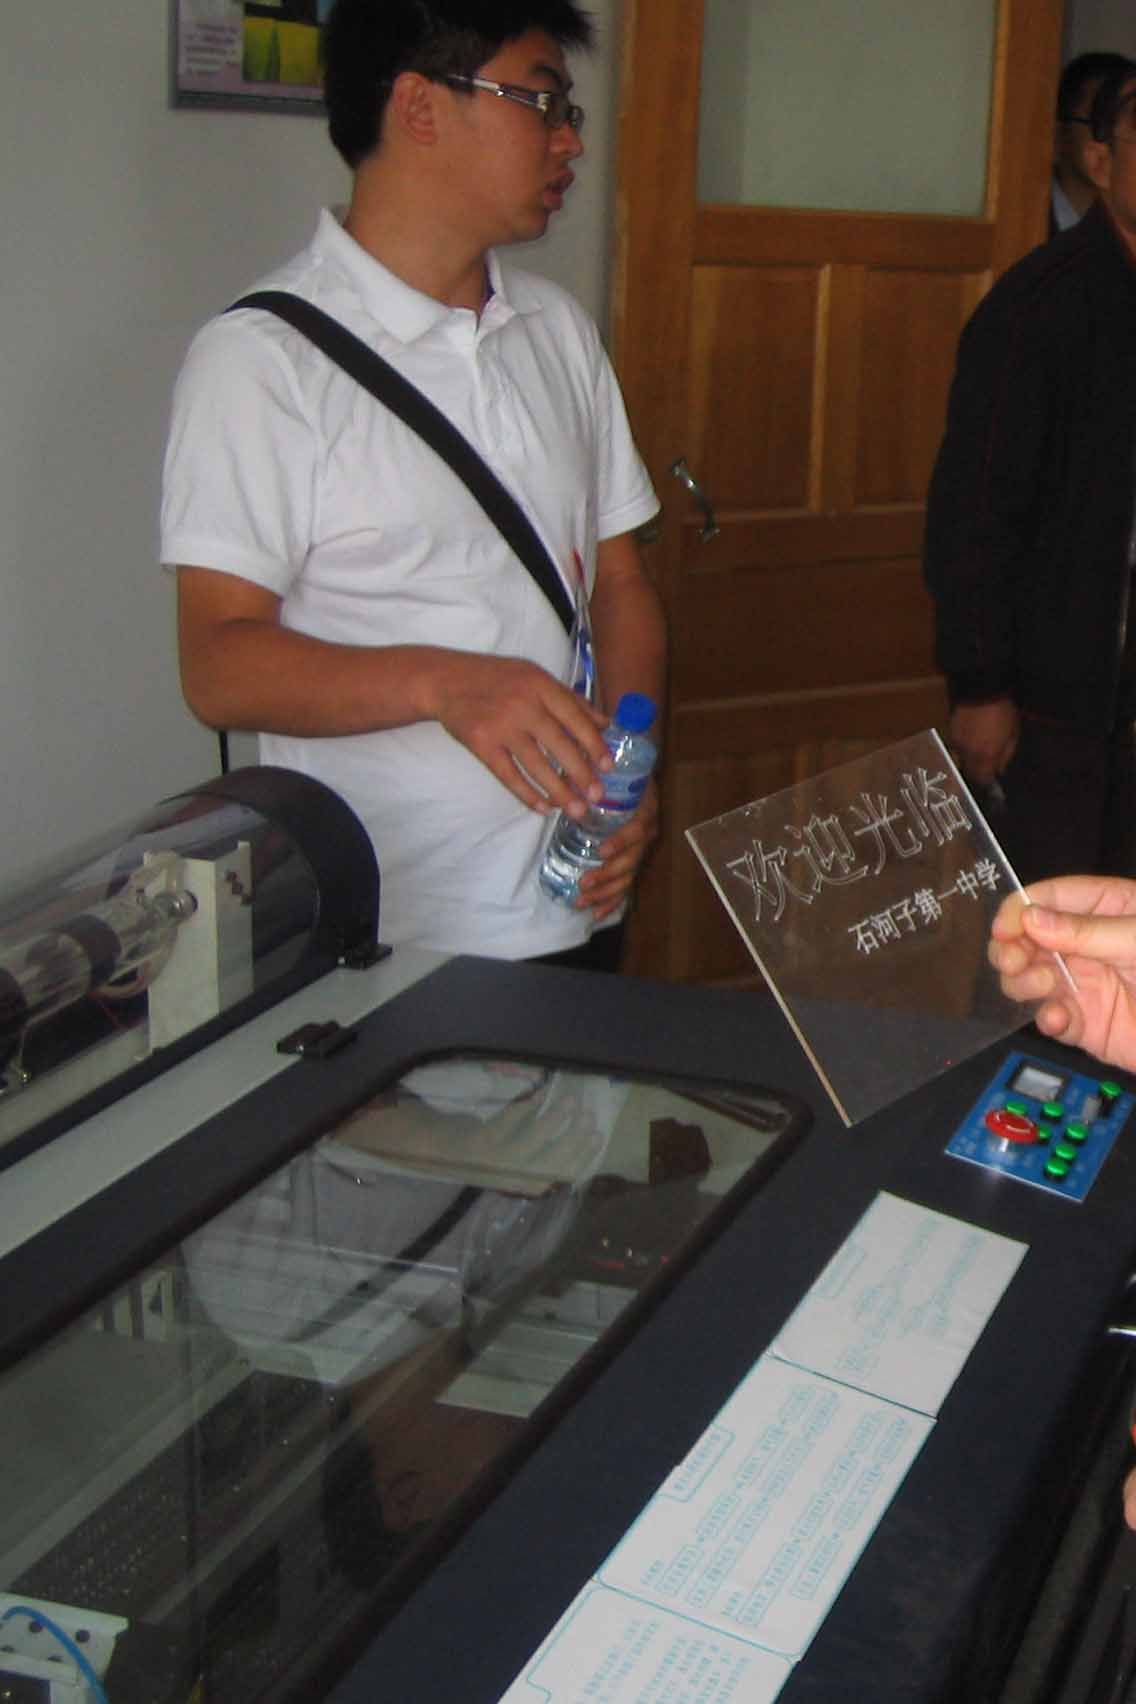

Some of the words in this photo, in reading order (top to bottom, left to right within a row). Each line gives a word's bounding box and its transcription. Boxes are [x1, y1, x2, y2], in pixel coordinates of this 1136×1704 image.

[726, 767, 972, 922] 欢迎光临
[847, 857, 1001, 955] 石河子第一中学
